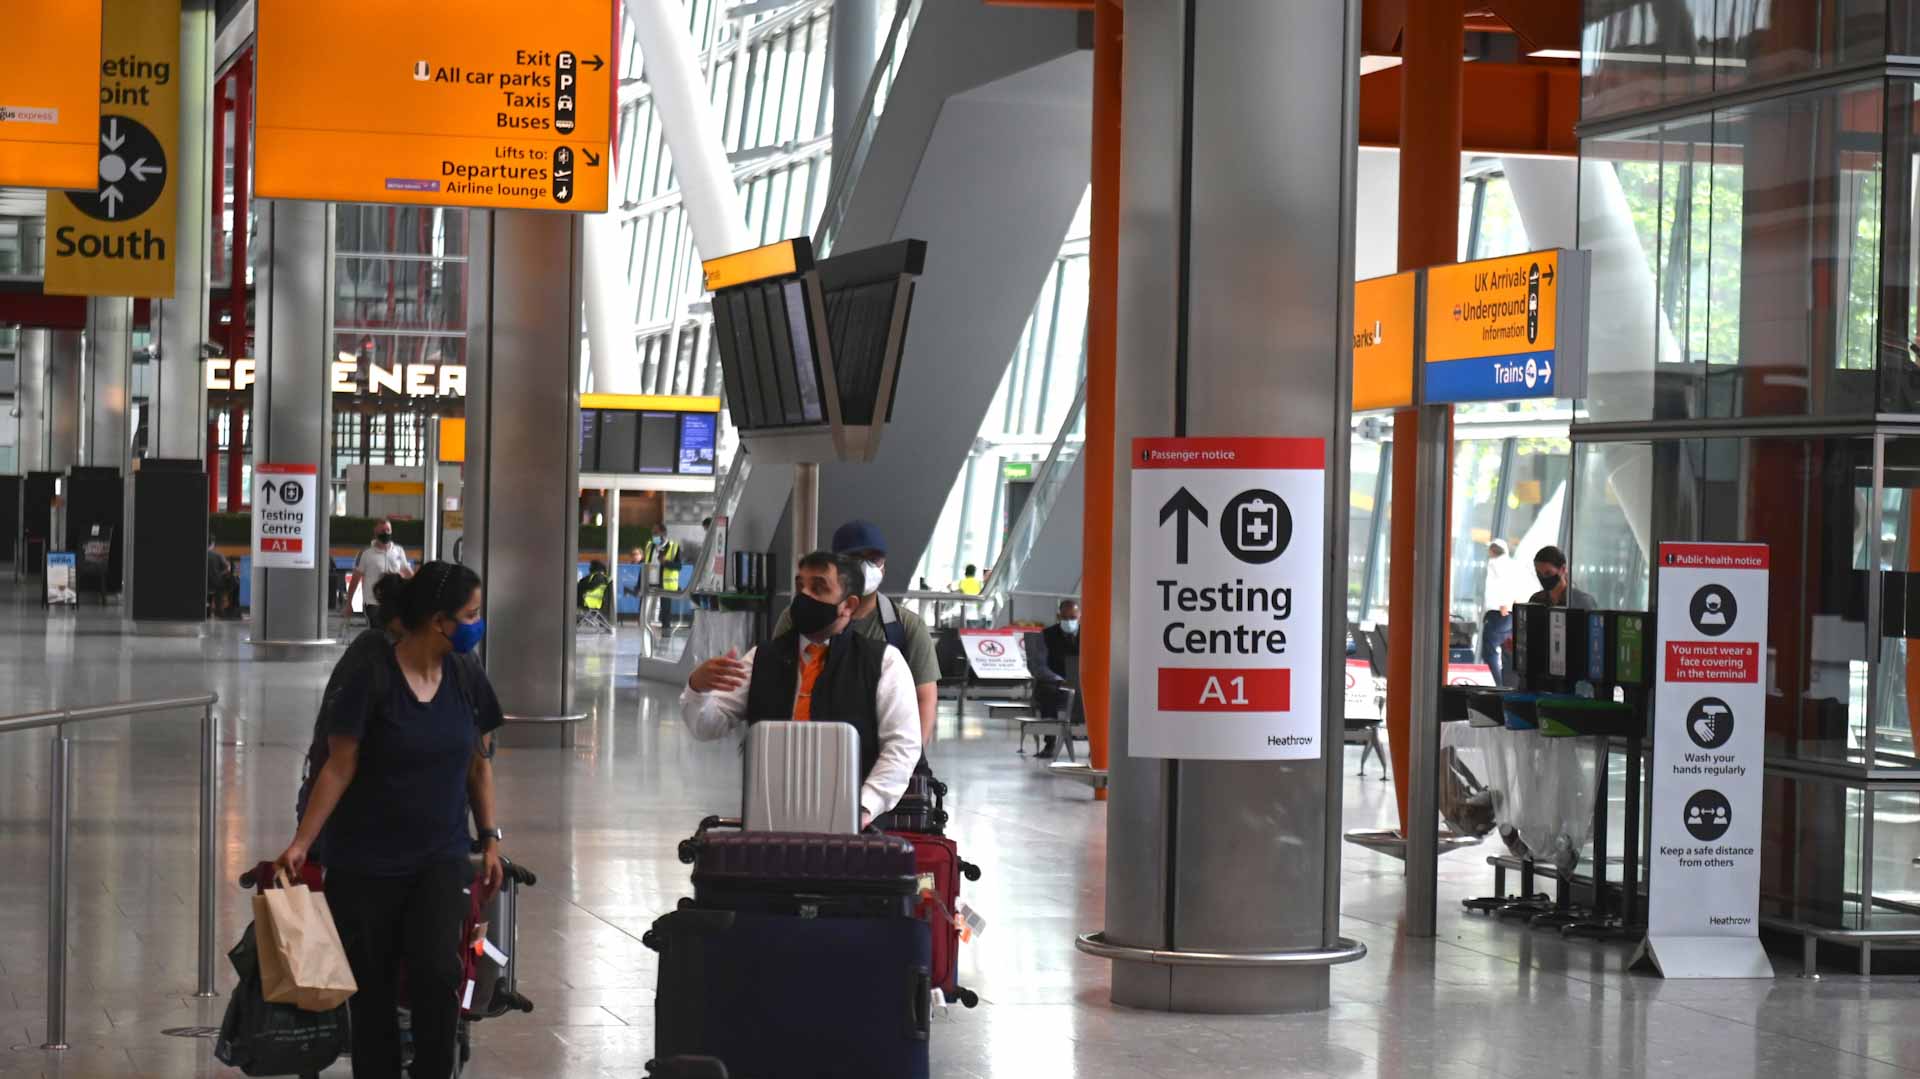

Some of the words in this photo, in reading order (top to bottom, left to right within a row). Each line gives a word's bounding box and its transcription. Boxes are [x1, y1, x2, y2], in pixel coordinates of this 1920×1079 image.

[516, 50, 551, 67] Exit
[102, 55, 170, 85] eting
[434, 67, 460, 83] All
[466, 71, 494, 84] car
[500, 71, 550, 89] parks
[100, 82, 149, 105] oint
[504, 91, 550, 108] Taxis
[497, 112, 550, 129] Buses
[495, 146, 525, 160] Lifts
[529, 148, 548, 160] to:
[442, 160, 548, 181] Departures
[446, 181, 493, 195] Airline
[498, 181, 547, 199] lounge
[56, 226, 166, 260] South
[1474, 273, 1489, 293] UK
[1490, 268, 1527, 289] Arrivals
[1463, 299, 1526, 323] Underground
[1482, 325, 1525, 341] Information
[1493, 361, 1524, 384] Trains
[1151, 449, 1200, 461] Passenger
[1201, 449, 1235, 460] notice
[261, 509, 303, 523] Testing
[262, 522, 302, 535] Centre
[271, 540, 288, 552] A1
[1676, 556, 1703, 565] Public
[1704, 556, 1733, 565] health
[1735, 557, 1762, 566] notice
[1157, 579, 1292, 620] Testing
[1163, 622, 1287, 654] Centre
[1672, 644, 1692, 655] You
[1693, 646, 1718, 655] must
[1720, 647, 1744, 655] wear
[1680, 656, 1700, 667] face
[1702, 657, 1744, 669] covering
[1676, 668, 1687, 678] in
[1688, 669, 1704, 678] the
[1705, 669, 1747, 679] terminal
[1199, 675, 1249, 705] A1
[1267, 735, 1312, 747] Heathrow
[1684, 753, 1711, 763] Wash
[1712, 754, 1736, 765] your
[1672, 764, 1702, 775] hands
[1704, 765, 1746, 777] regularly
[1660, 846, 1684, 856] Keep
[1694, 846, 1714, 855] safe
[1715, 846, 1754, 856] distance
[1679, 858, 1702, 867] from
[1704, 858, 1734, 867] others
[1710, 916, 1751, 925] Heathrow
